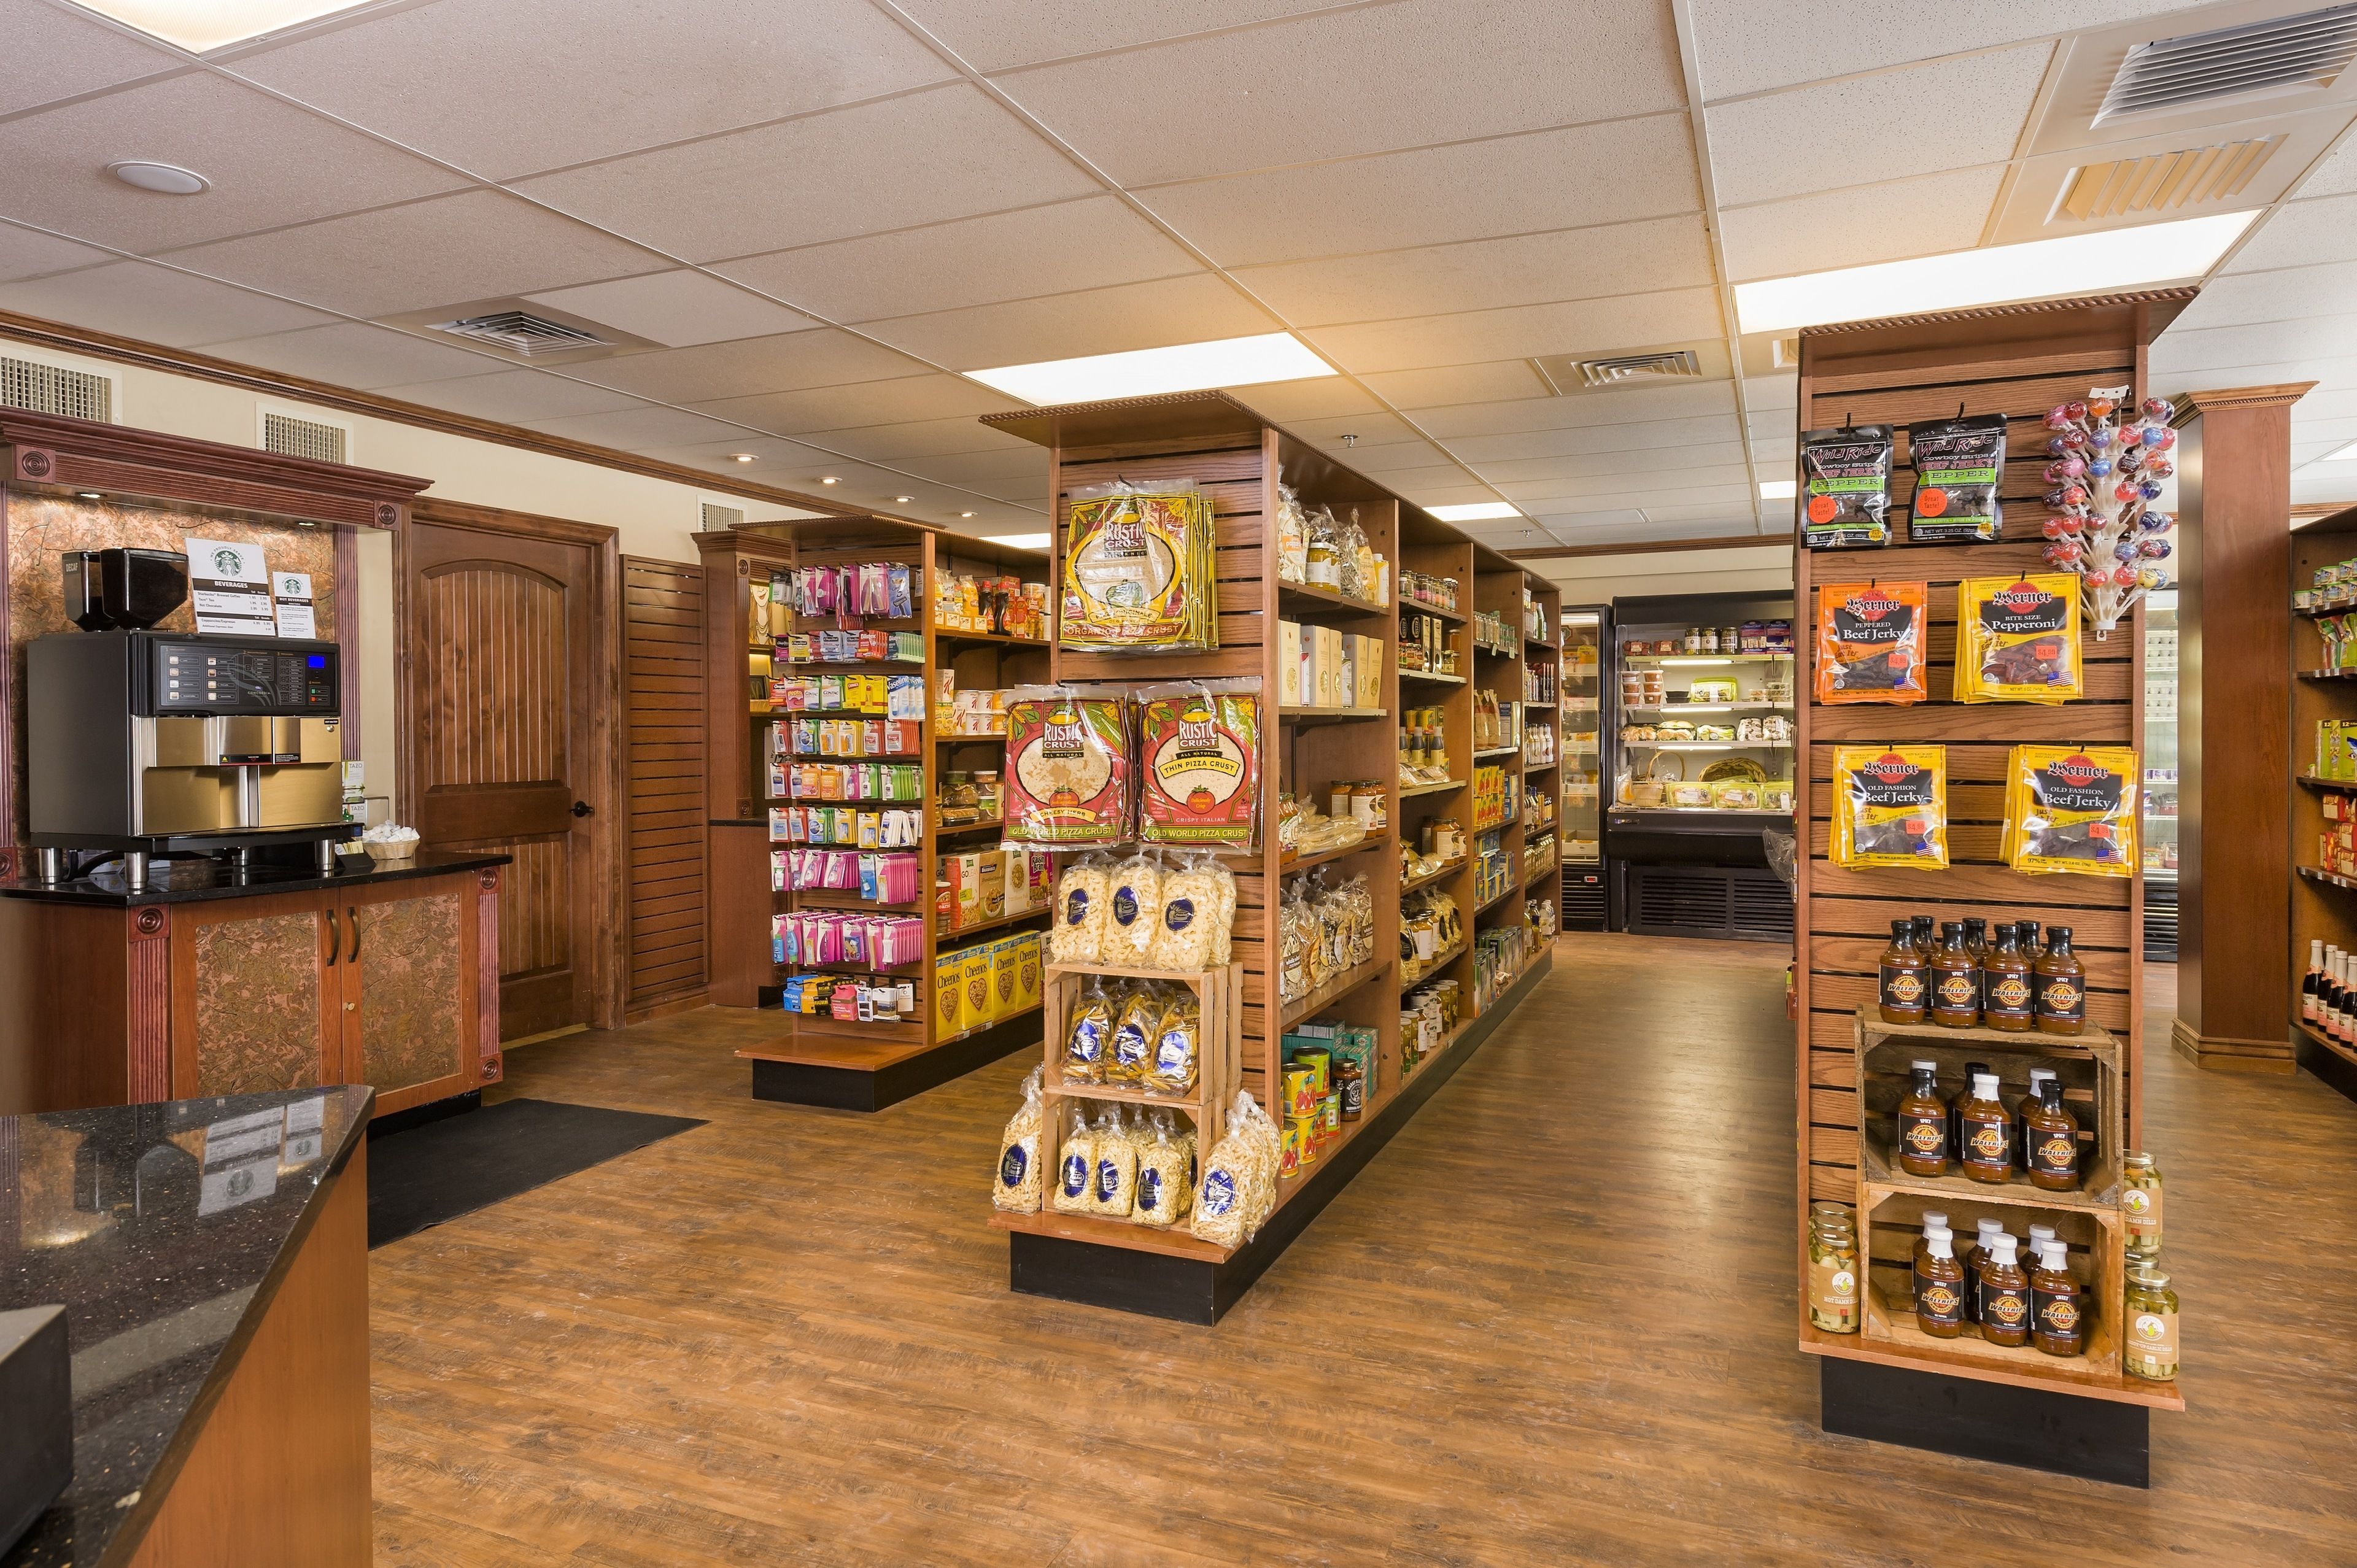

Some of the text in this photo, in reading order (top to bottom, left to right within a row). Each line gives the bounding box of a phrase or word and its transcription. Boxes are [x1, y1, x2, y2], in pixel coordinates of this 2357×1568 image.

[1811, 444, 1882, 465] Wild Ride
[1919, 458, 1994, 471] BEEF JERKY
[1925, 471, 1989, 481] PEPPER
[1815, 479, 1880, 487] PEPPER
[1105, 539, 1145, 548] CRUST
[66, 563, 78, 572] DECAF
[1993, 590, 2053, 605] Werner
[1846, 598, 1900, 614] Werner
[1147, 625, 1178, 635] CRUST
[1992, 618, 2056, 632] Pepperoni
[1843, 628, 1904, 641] Beef Jerky
[888, 676, 909, 690] Vaseline
[1179, 719, 1217, 740] RUSTIC
[1180, 738, 1217, 747] CRUST
[1164, 764, 1183, 774] THIN
[1210, 761, 1234, 771] CRUST
[1864, 762, 1919, 775] Werner
[2048, 762, 2110, 778] Werner
[1865, 792, 1924, 804] Beef Jerky
[2043, 793, 2111, 809] Beef Jerky
[1032, 855, 1045, 865] Raisin
[1033, 863, 1045, 873] Bran
[1020, 949, 1037, 962] Cheerios
[997, 956, 1015, 971] Cheerios
[966, 963, 987, 978] Cheerios
[938, 972, 960, 989] Cheerios
[1940, 986, 1976, 994] WALTRIP'S
[2043, 992, 2081, 1001] WALTRIP'S
[1972, 1138, 2008, 1148] WALTRIP'S
[1922, 1294, 1959, 1305] WALTRIP'S
[1991, 1303, 2027, 1313] WALTRIP'S
[2043, 1310, 2080, 1320] WALTRIP'S
